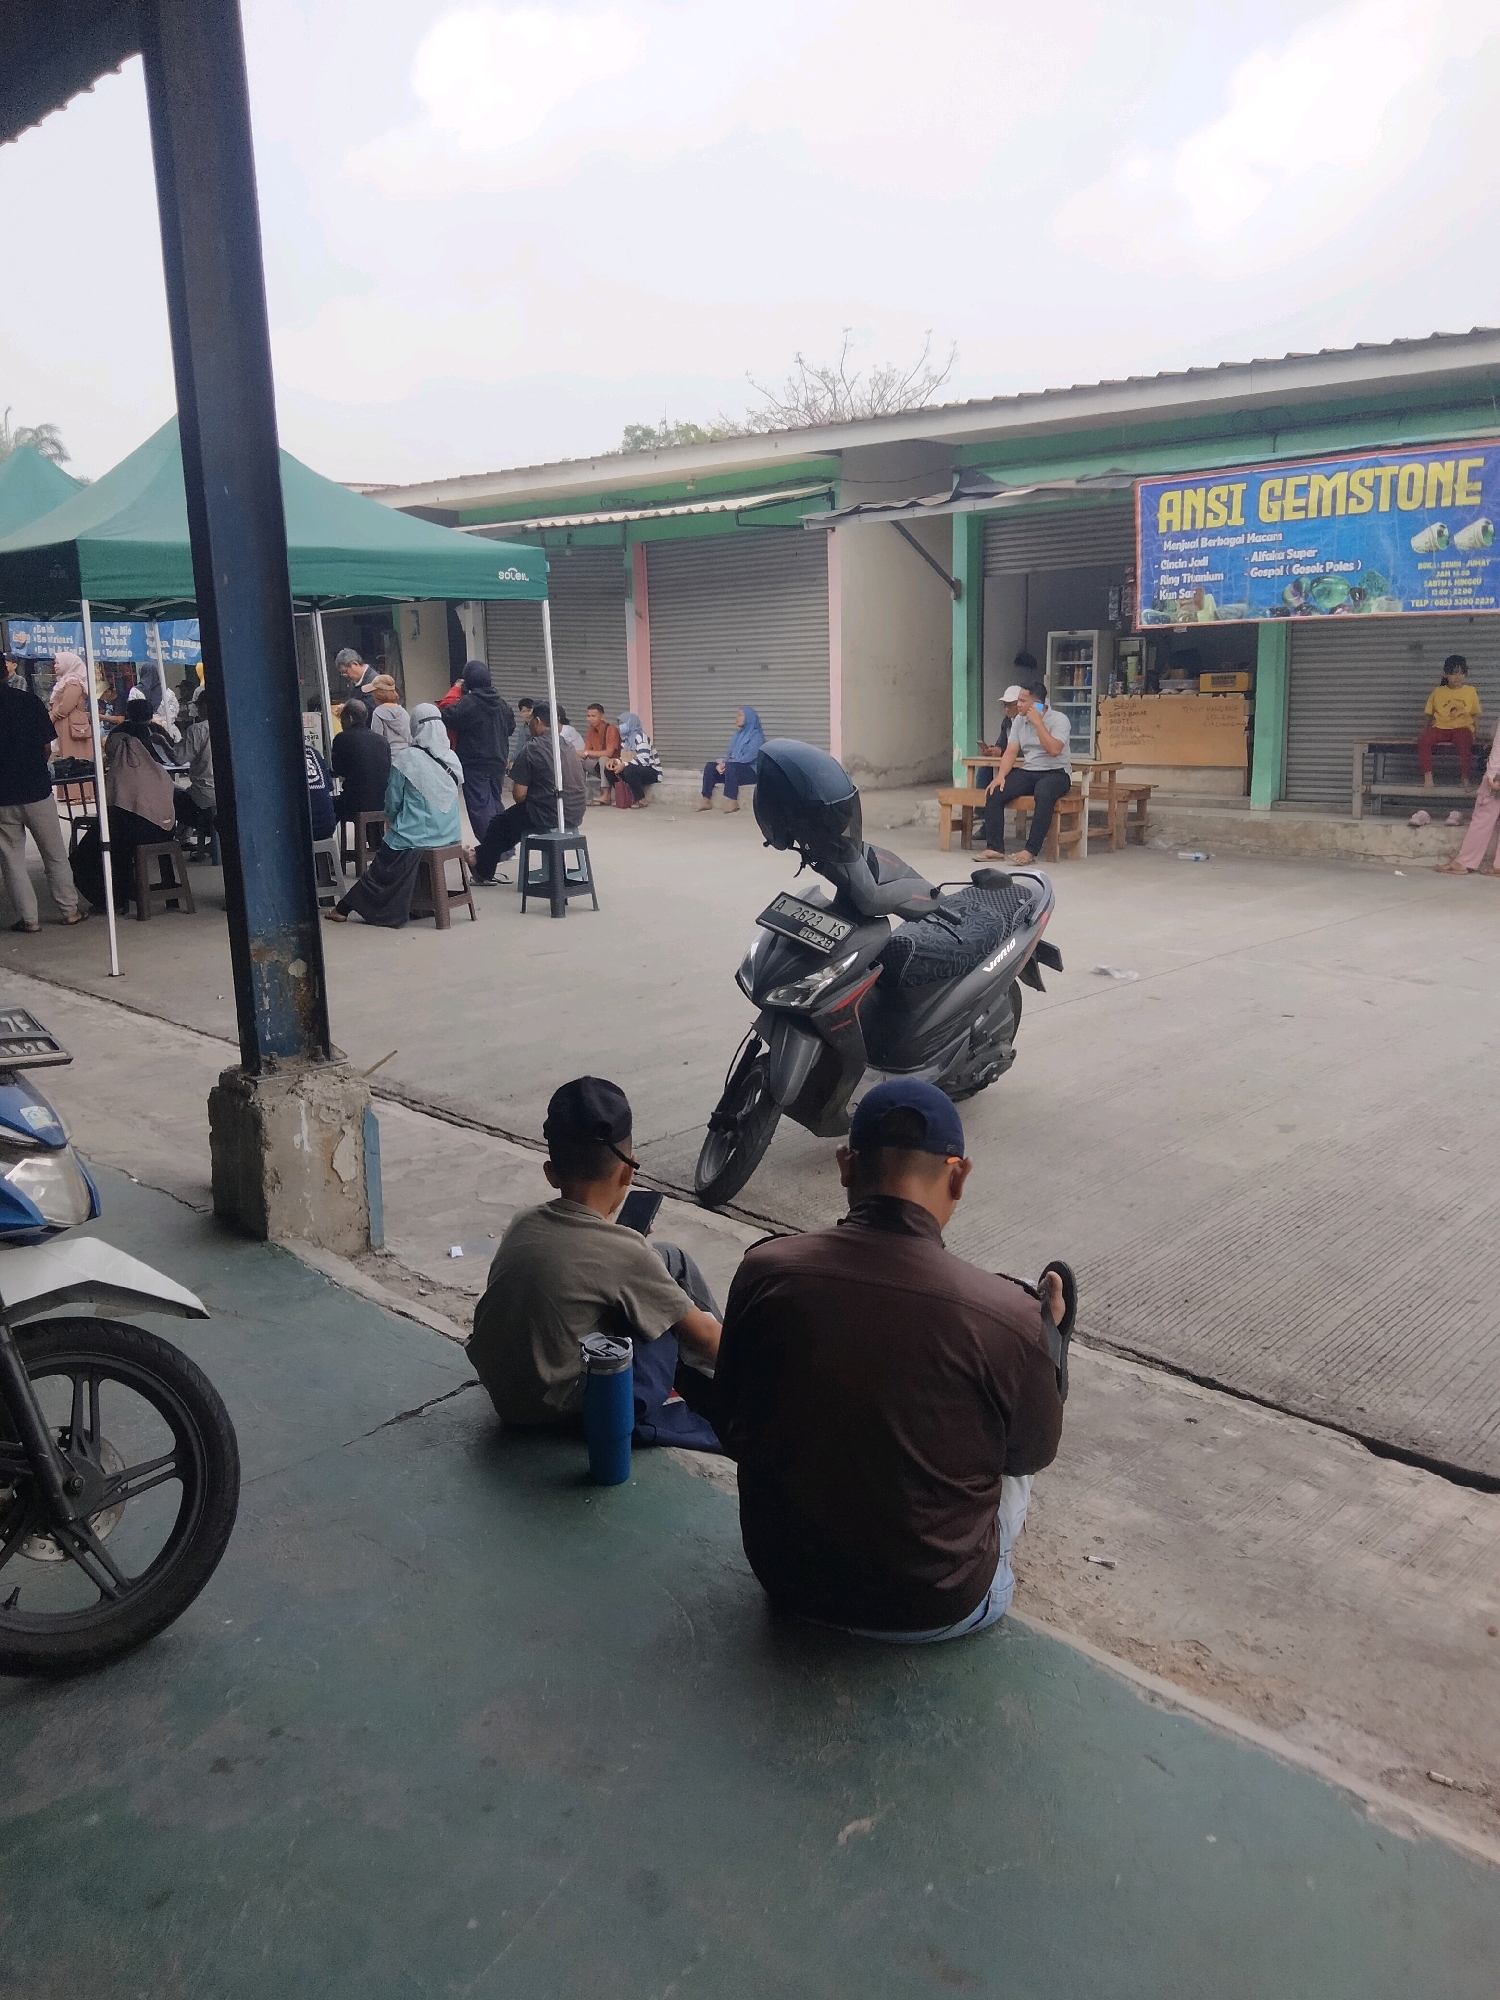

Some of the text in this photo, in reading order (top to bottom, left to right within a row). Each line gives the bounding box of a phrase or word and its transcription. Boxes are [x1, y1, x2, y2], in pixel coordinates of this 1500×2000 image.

[1157, 458, 1484, 533] ANSI GEMSTONE
[1163, 533, 1283, 552] Menjual Berbagai Macam
[1286, 548, 1318, 560] Super
[1188, 556, 1209, 568] Jadi
[1293, 562, 1324, 575] Gosok
[1326, 560, 1355, 573] Poles
[1159, 575, 1180, 587] Ring
[1182, 572, 1224, 584] Titanium
[1411, 599, 1429, 607] TELP
[774, 899, 846, 938] A 2623 YS
